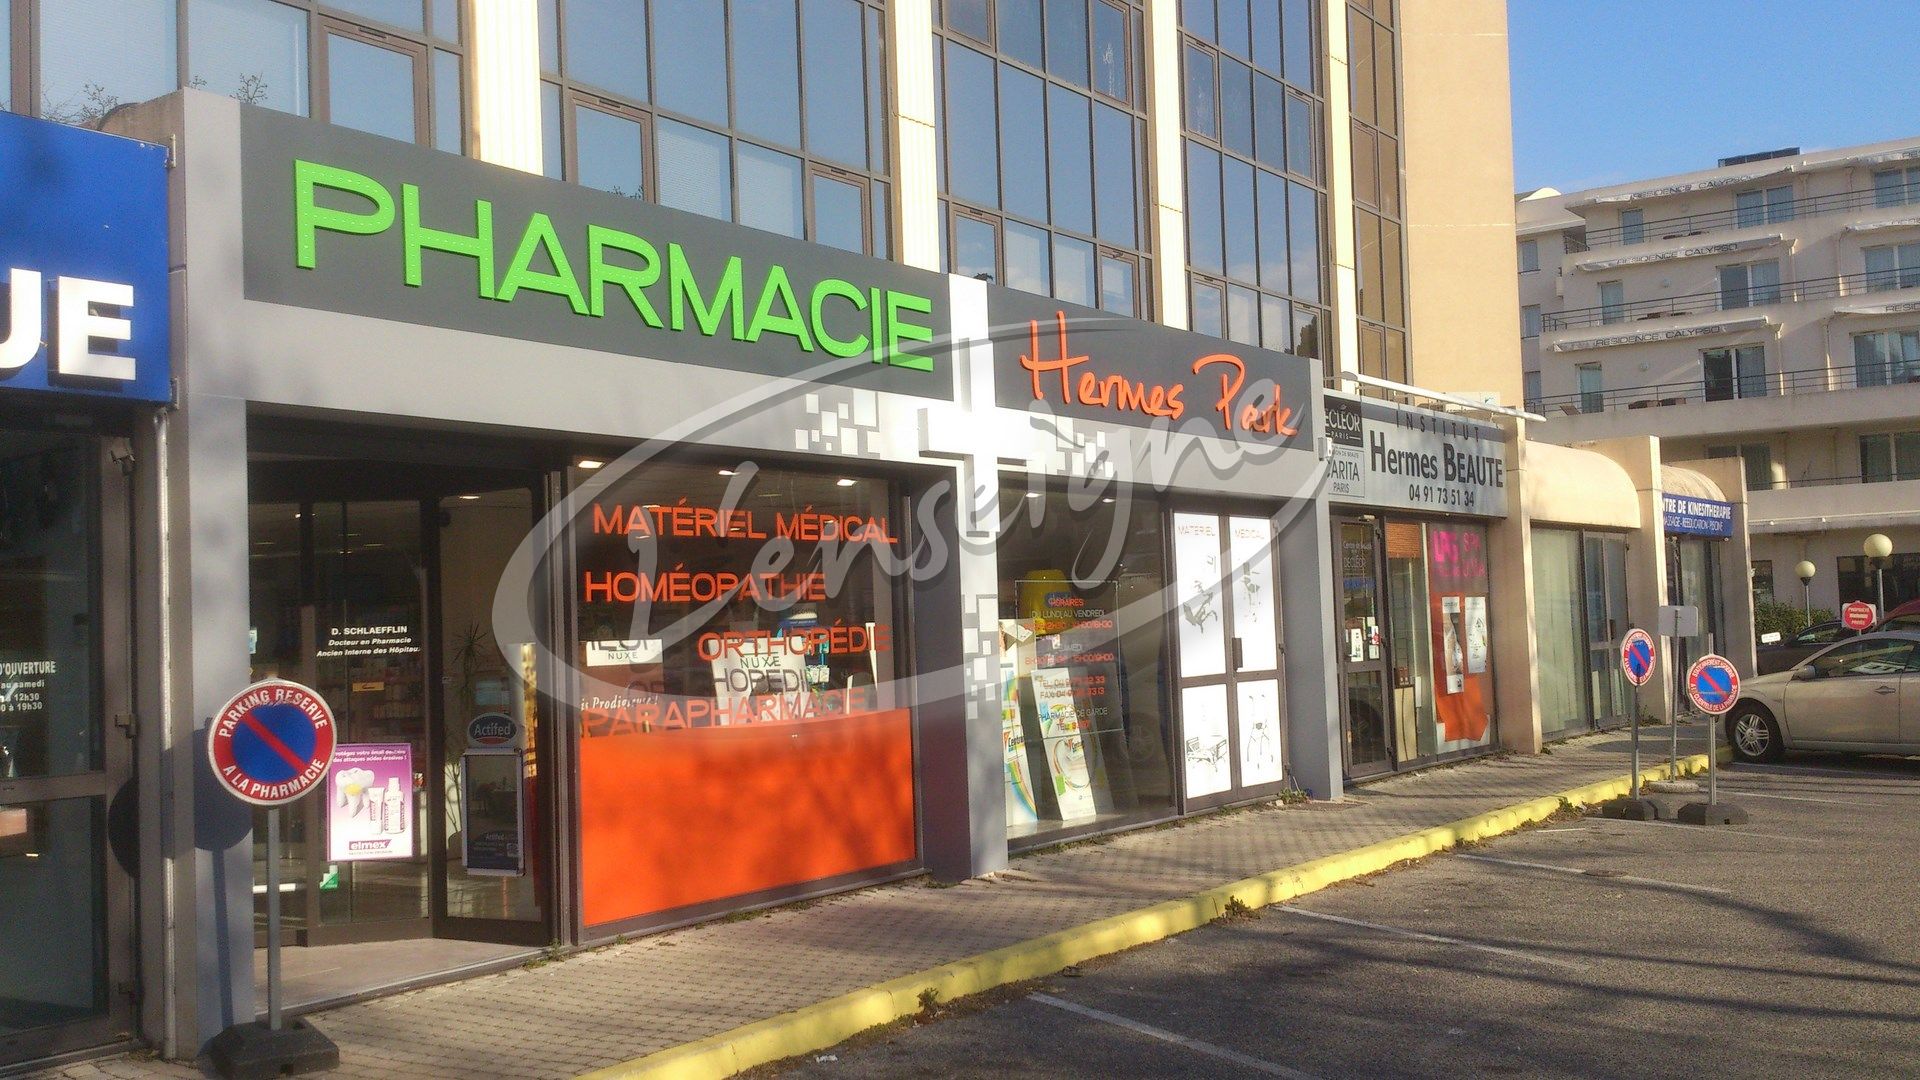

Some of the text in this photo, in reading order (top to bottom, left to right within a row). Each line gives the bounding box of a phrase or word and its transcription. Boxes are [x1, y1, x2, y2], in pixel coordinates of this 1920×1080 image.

[294, 159, 934, 371] PHARMACIE
[1020, 311, 1298, 436] Hermes Park
[1396, 410, 1479, 442] INSTITUT
[1331, 431, 1349, 440] PARIS
[1370, 430, 1504, 488] Hermes BEAUTE
[1333, 482, 1350, 493] PARIS
[1409, 484, 1474, 507] 04 91 73 51 34
[1678, 500, 1687, 514] DE
[593, 497, 898, 543] MATÉRIEL MÉDICAL
[585, 563, 827, 603] HOMÉOPATHIE
[344, 626, 407, 635] SCHLAEFFLIN
[372, 637, 412, 645] Pharmacie
[697, 618, 891, 661] ORTHOPÉDIE
[345, 648, 372, 656] Interne
[608, 652, 638, 660] NUXE
[740, 655, 781, 668] NUXE
[14, 692, 40, 702] 12h30
[17, 702, 43, 711] 19h30
[219, 688, 328, 738] PARKING RESERVE
[581, 688, 865, 737] PARAPHARMACIE
[474, 723, 511, 736] Actifed
[223, 759, 325, 798] A LA PHARMACIE
[350, 840, 387, 851] elmex
